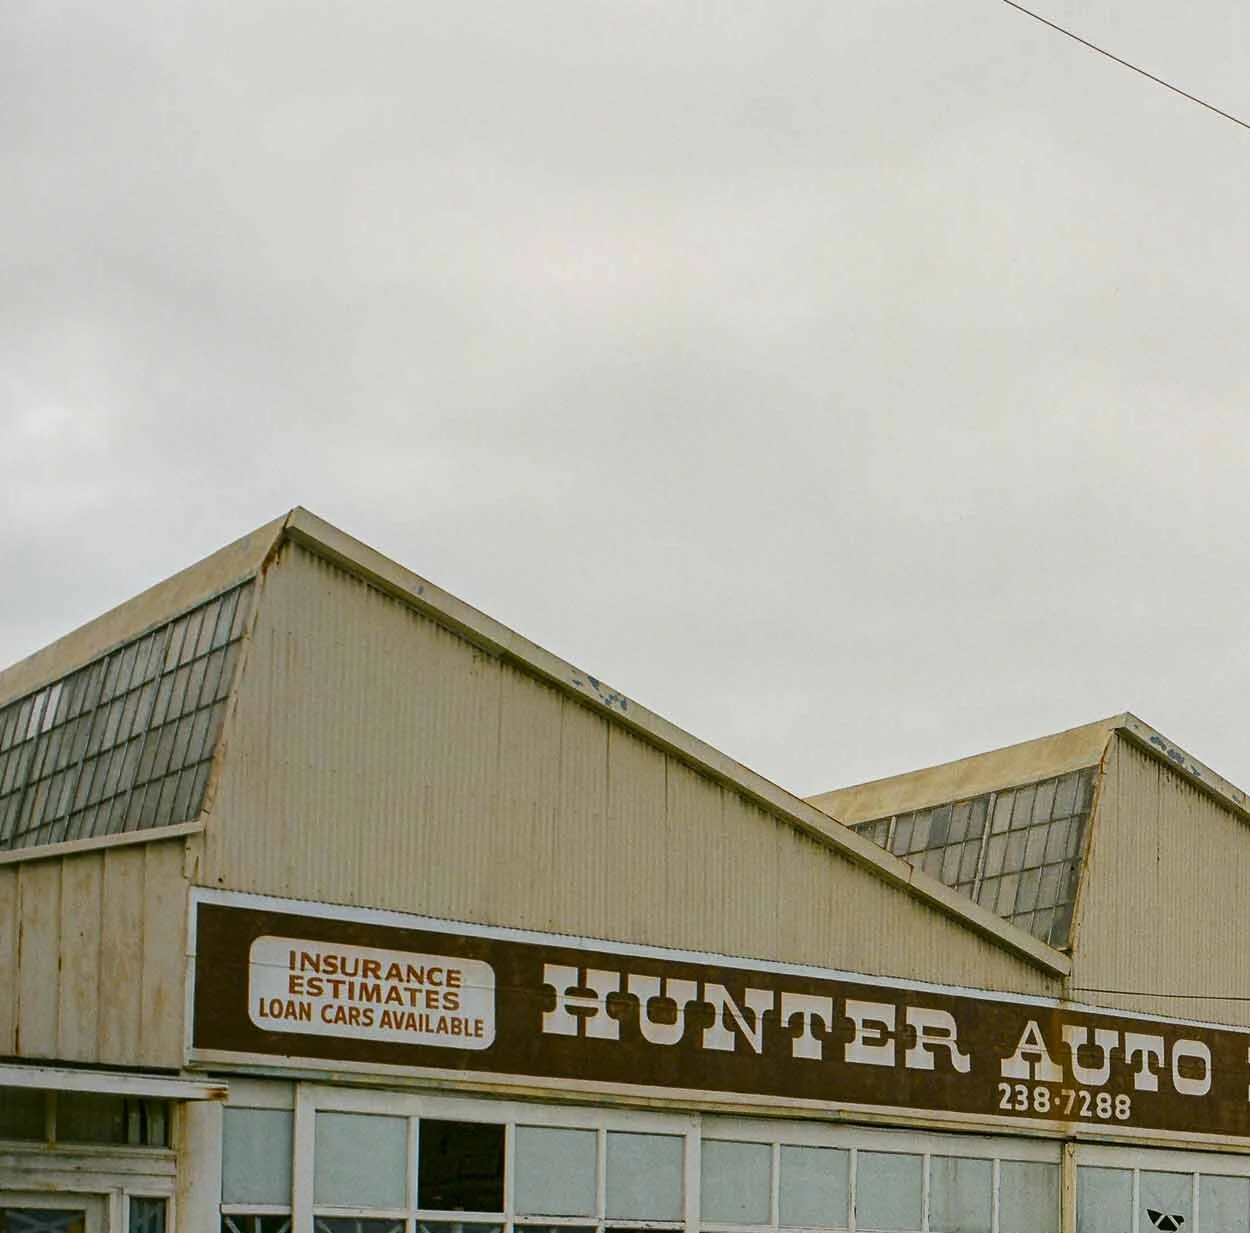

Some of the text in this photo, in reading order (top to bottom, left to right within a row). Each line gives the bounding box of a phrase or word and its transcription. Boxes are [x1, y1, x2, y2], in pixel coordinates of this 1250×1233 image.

[289, 950, 461, 988] INSURANCE
[288, 975, 460, 1011] ESTIMATES
[259, 997, 484, 1038] LOAN CARS AVAILABLE
[542, 963, 971, 1073] HUNTER
[1001, 1020, 1212, 1096] AUTO
